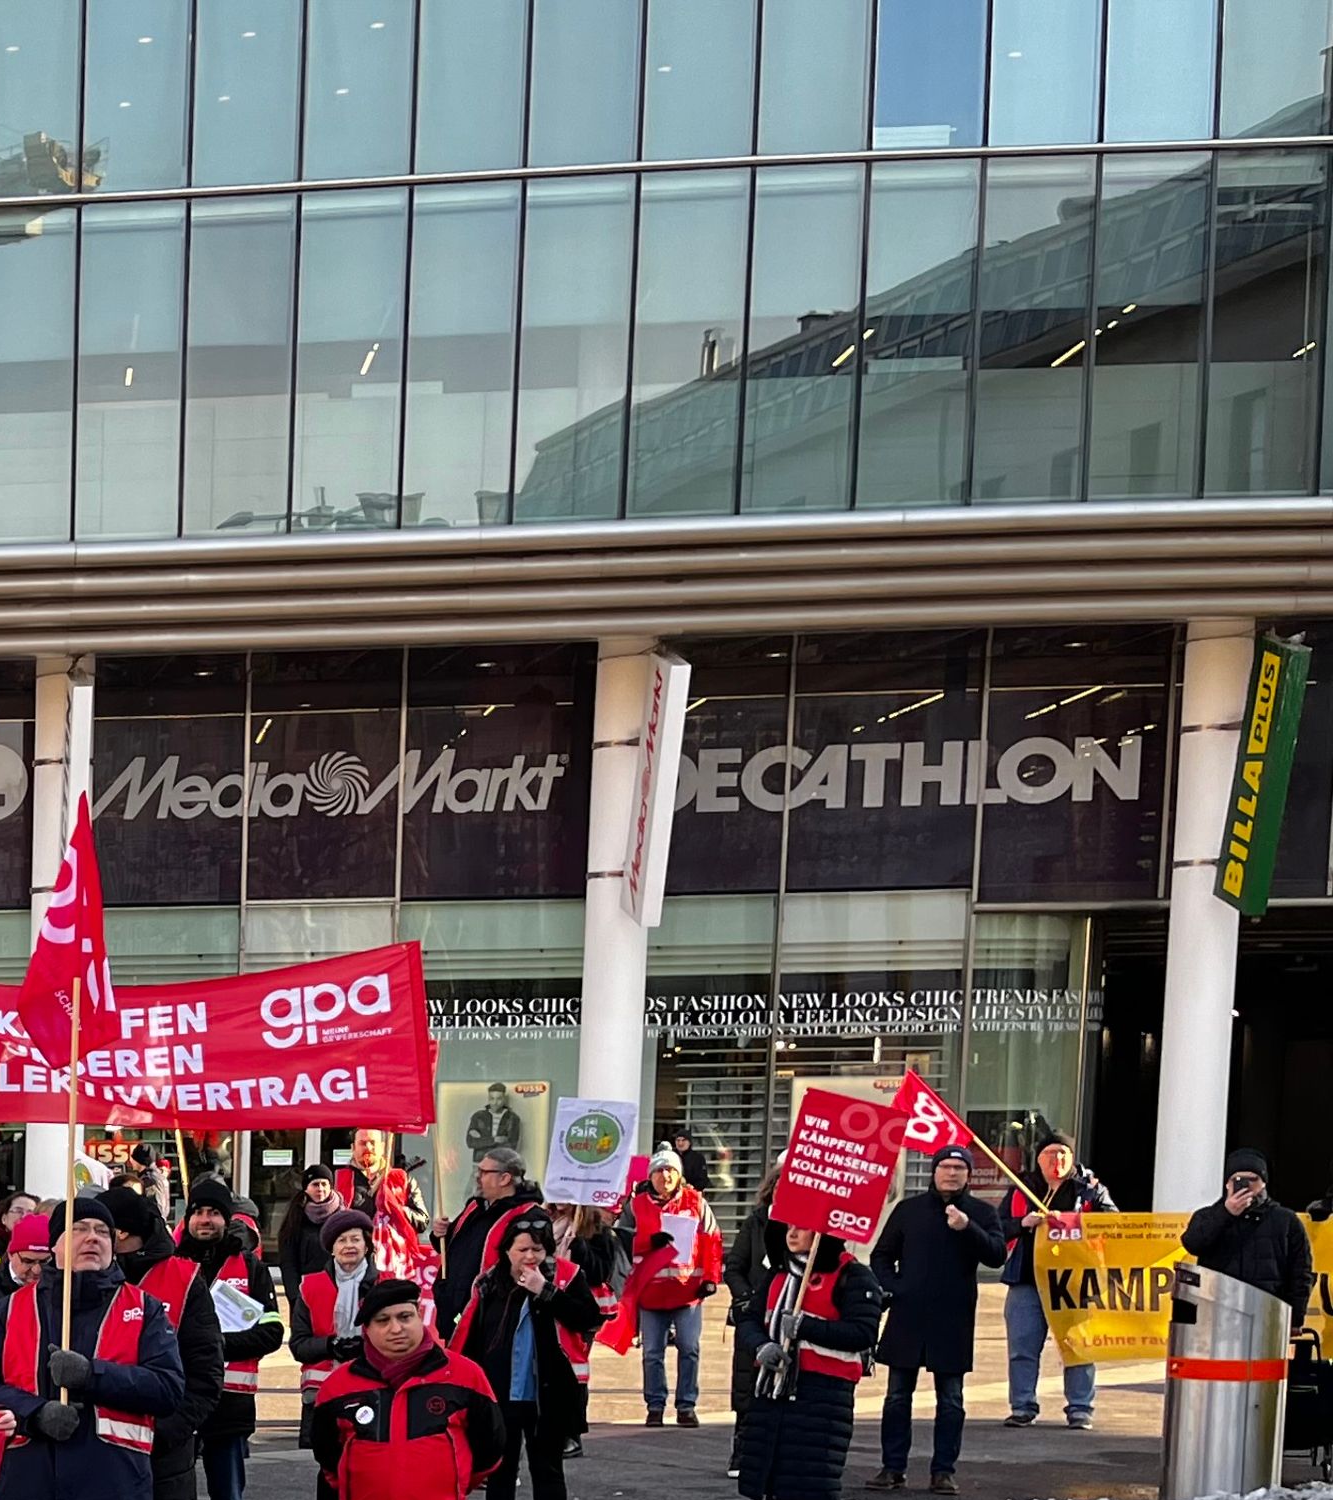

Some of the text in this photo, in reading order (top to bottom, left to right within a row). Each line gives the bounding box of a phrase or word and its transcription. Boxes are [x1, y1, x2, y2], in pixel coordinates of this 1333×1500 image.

[1253, 661, 1278, 744] PLUS
[92, 748, 565, 821] Media Markt
[673, 735, 1141, 813] DECATHLON
[1221, 757, 1265, 899] BILLA
[260, 973, 392, 1049] gpa
[453, 997, 580, 1014] LOOKS CHIC
[673, 994, 767, 1011] FASHION
[778, 992, 827, 1009] NEW
[831, 990, 905, 1008] LOOKS
[910, 989, 965, 1006] CHIC
[507, 1013, 579, 1029] DESIGN
[793, 1007, 881, 1024] FEELING
[887, 1006, 962, 1023] DESIGN
[804, 1115, 831, 1131] WIR
[798, 1129, 866, 1156] KÄMPFEN
[790, 1158, 870, 1185] KOLLEKTIV-
[794, 1143, 889, 1177] FÜR UNSEREN
[787, 1171, 852, 1199] VERTRAG!
[828, 1209, 872, 1232] gpa
[1048, 1228, 1082, 1241] GLB
[1047, 1267, 1175, 1312] KAMP
